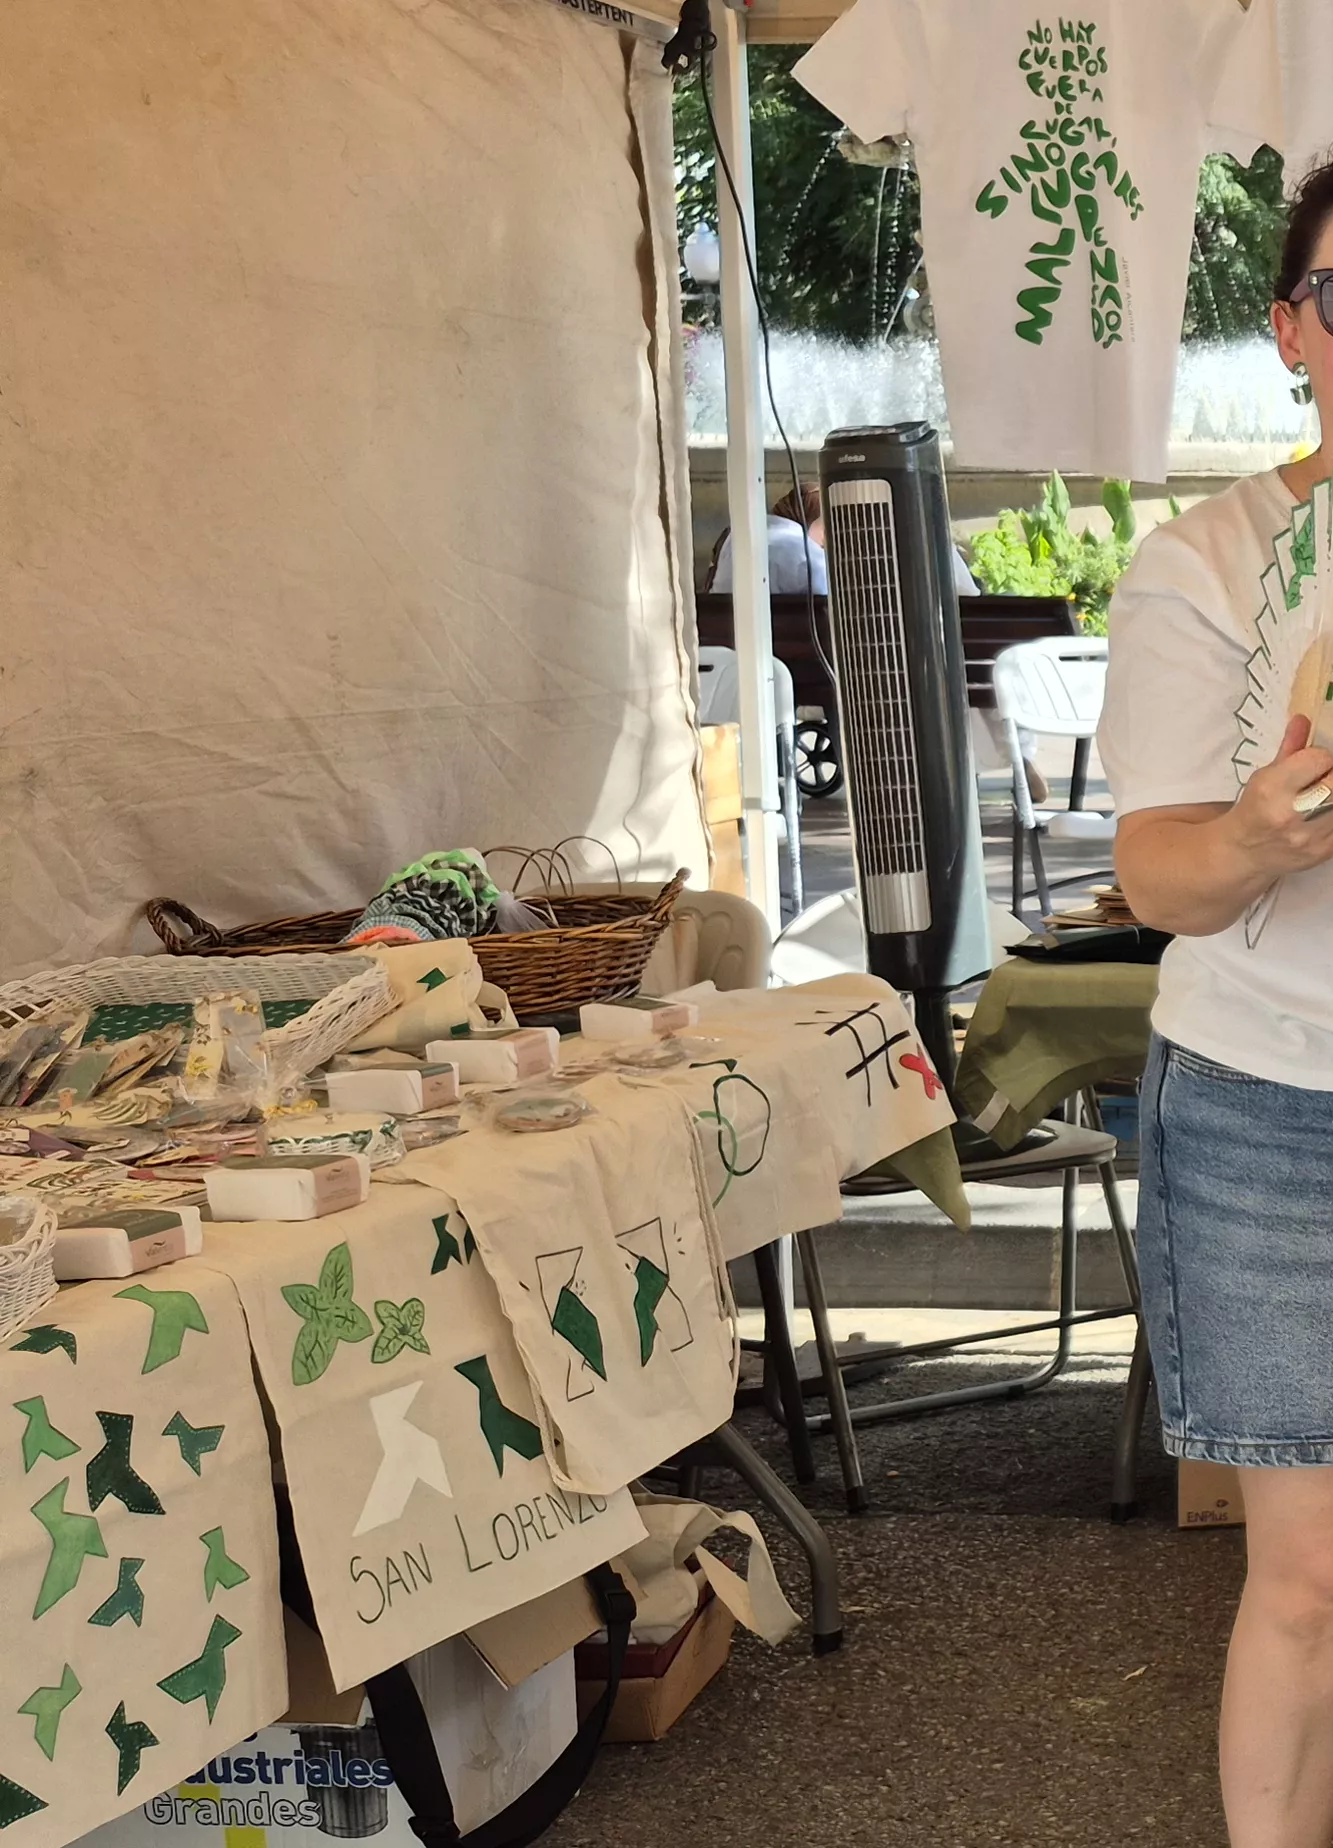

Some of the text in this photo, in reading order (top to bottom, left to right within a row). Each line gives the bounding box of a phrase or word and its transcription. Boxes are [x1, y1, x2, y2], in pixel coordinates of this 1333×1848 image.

[557, 0, 636, 26] STERTENT
[1027, 17, 1096, 45] NO HAY
[1019, 45, 1108, 76] CUERPOS
[1026, 70, 1103, 102] FUERA
[1054, 101, 1073, 115] DE
[975, 142, 1066, 219] SINO
[350, 1487, 608, 1625] SAN LORENZO
[183, 1751, 394, 1787] ustriales
[144, 1791, 322, 1827] Grandes
